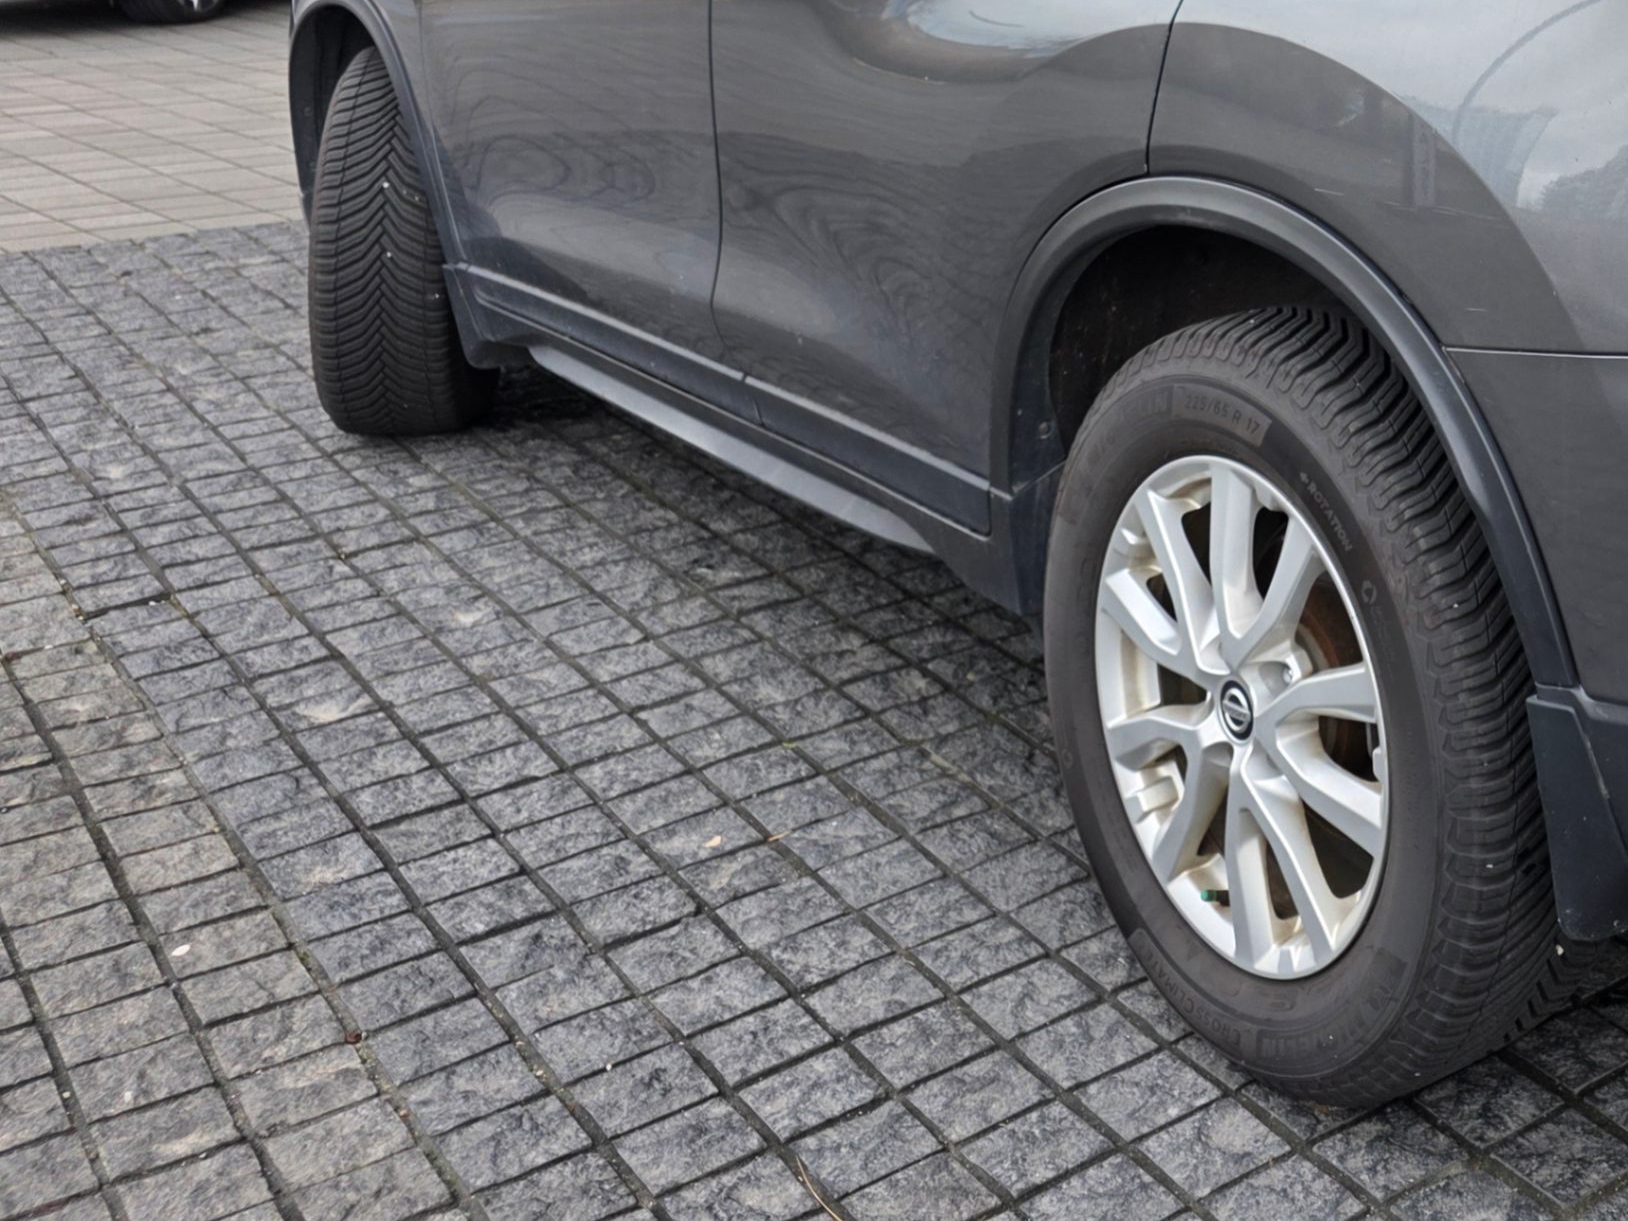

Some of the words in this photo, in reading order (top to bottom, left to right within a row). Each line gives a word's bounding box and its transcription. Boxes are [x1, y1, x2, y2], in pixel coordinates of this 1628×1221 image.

[1184, 394, 1229, 418] 225/65
[1232, 409, 1242, 426] R
[1247, 417, 1261, 434] 17
[1306, 482, 1352, 552] ROTATION
